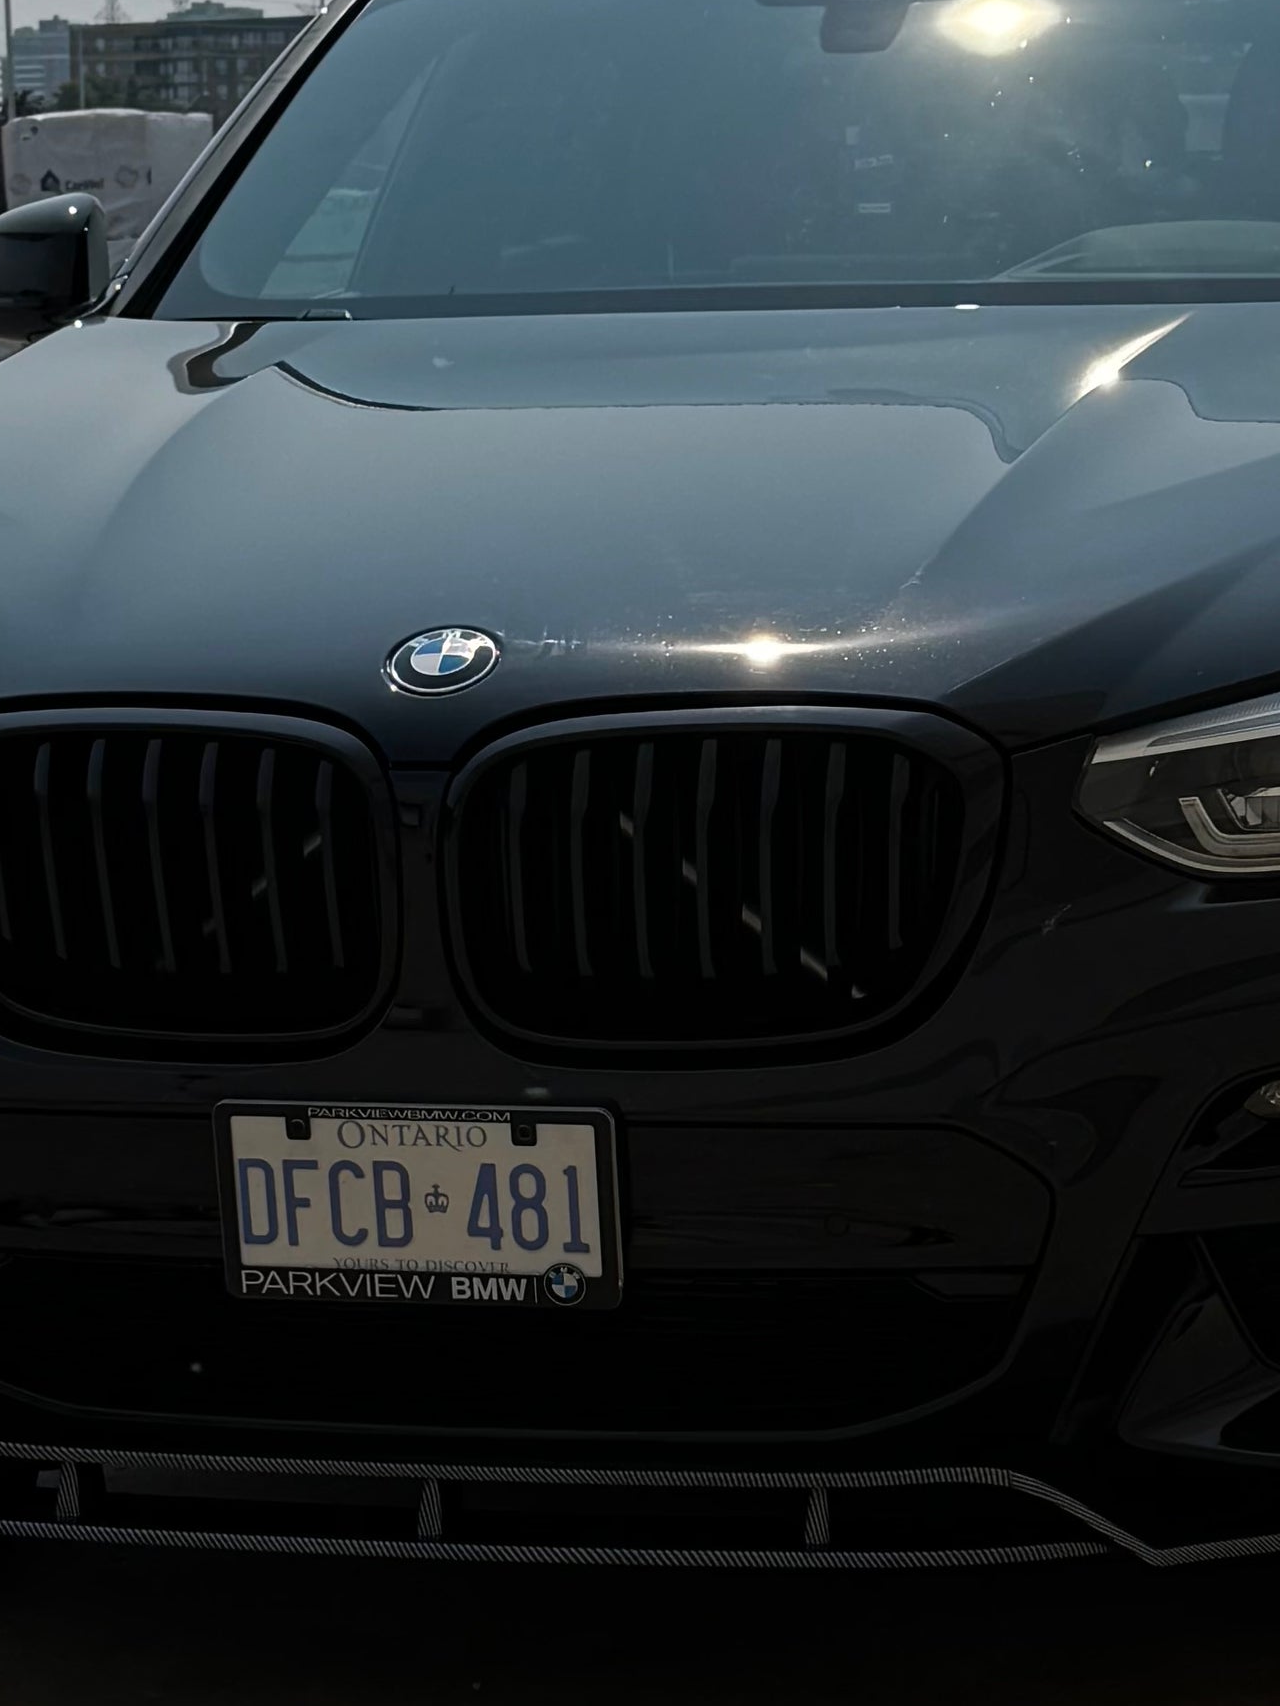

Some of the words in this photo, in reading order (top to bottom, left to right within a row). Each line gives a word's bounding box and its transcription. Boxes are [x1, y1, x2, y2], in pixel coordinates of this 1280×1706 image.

[308, 1106, 511, 1122] PARKVIEWBMW.COM
[337, 1120, 487, 1151] ONTARIO
[238, 1158, 414, 1248] DFCB
[467, 1163, 590, 1253] 481
[333, 1257, 389, 1270] YOURS
[395, 1259, 418, 1271] TO
[425, 1260, 511, 1273] DISCOVER
[240, 1270, 435, 1299] PARKVIEW
[451, 1276, 527, 1301] BMW
